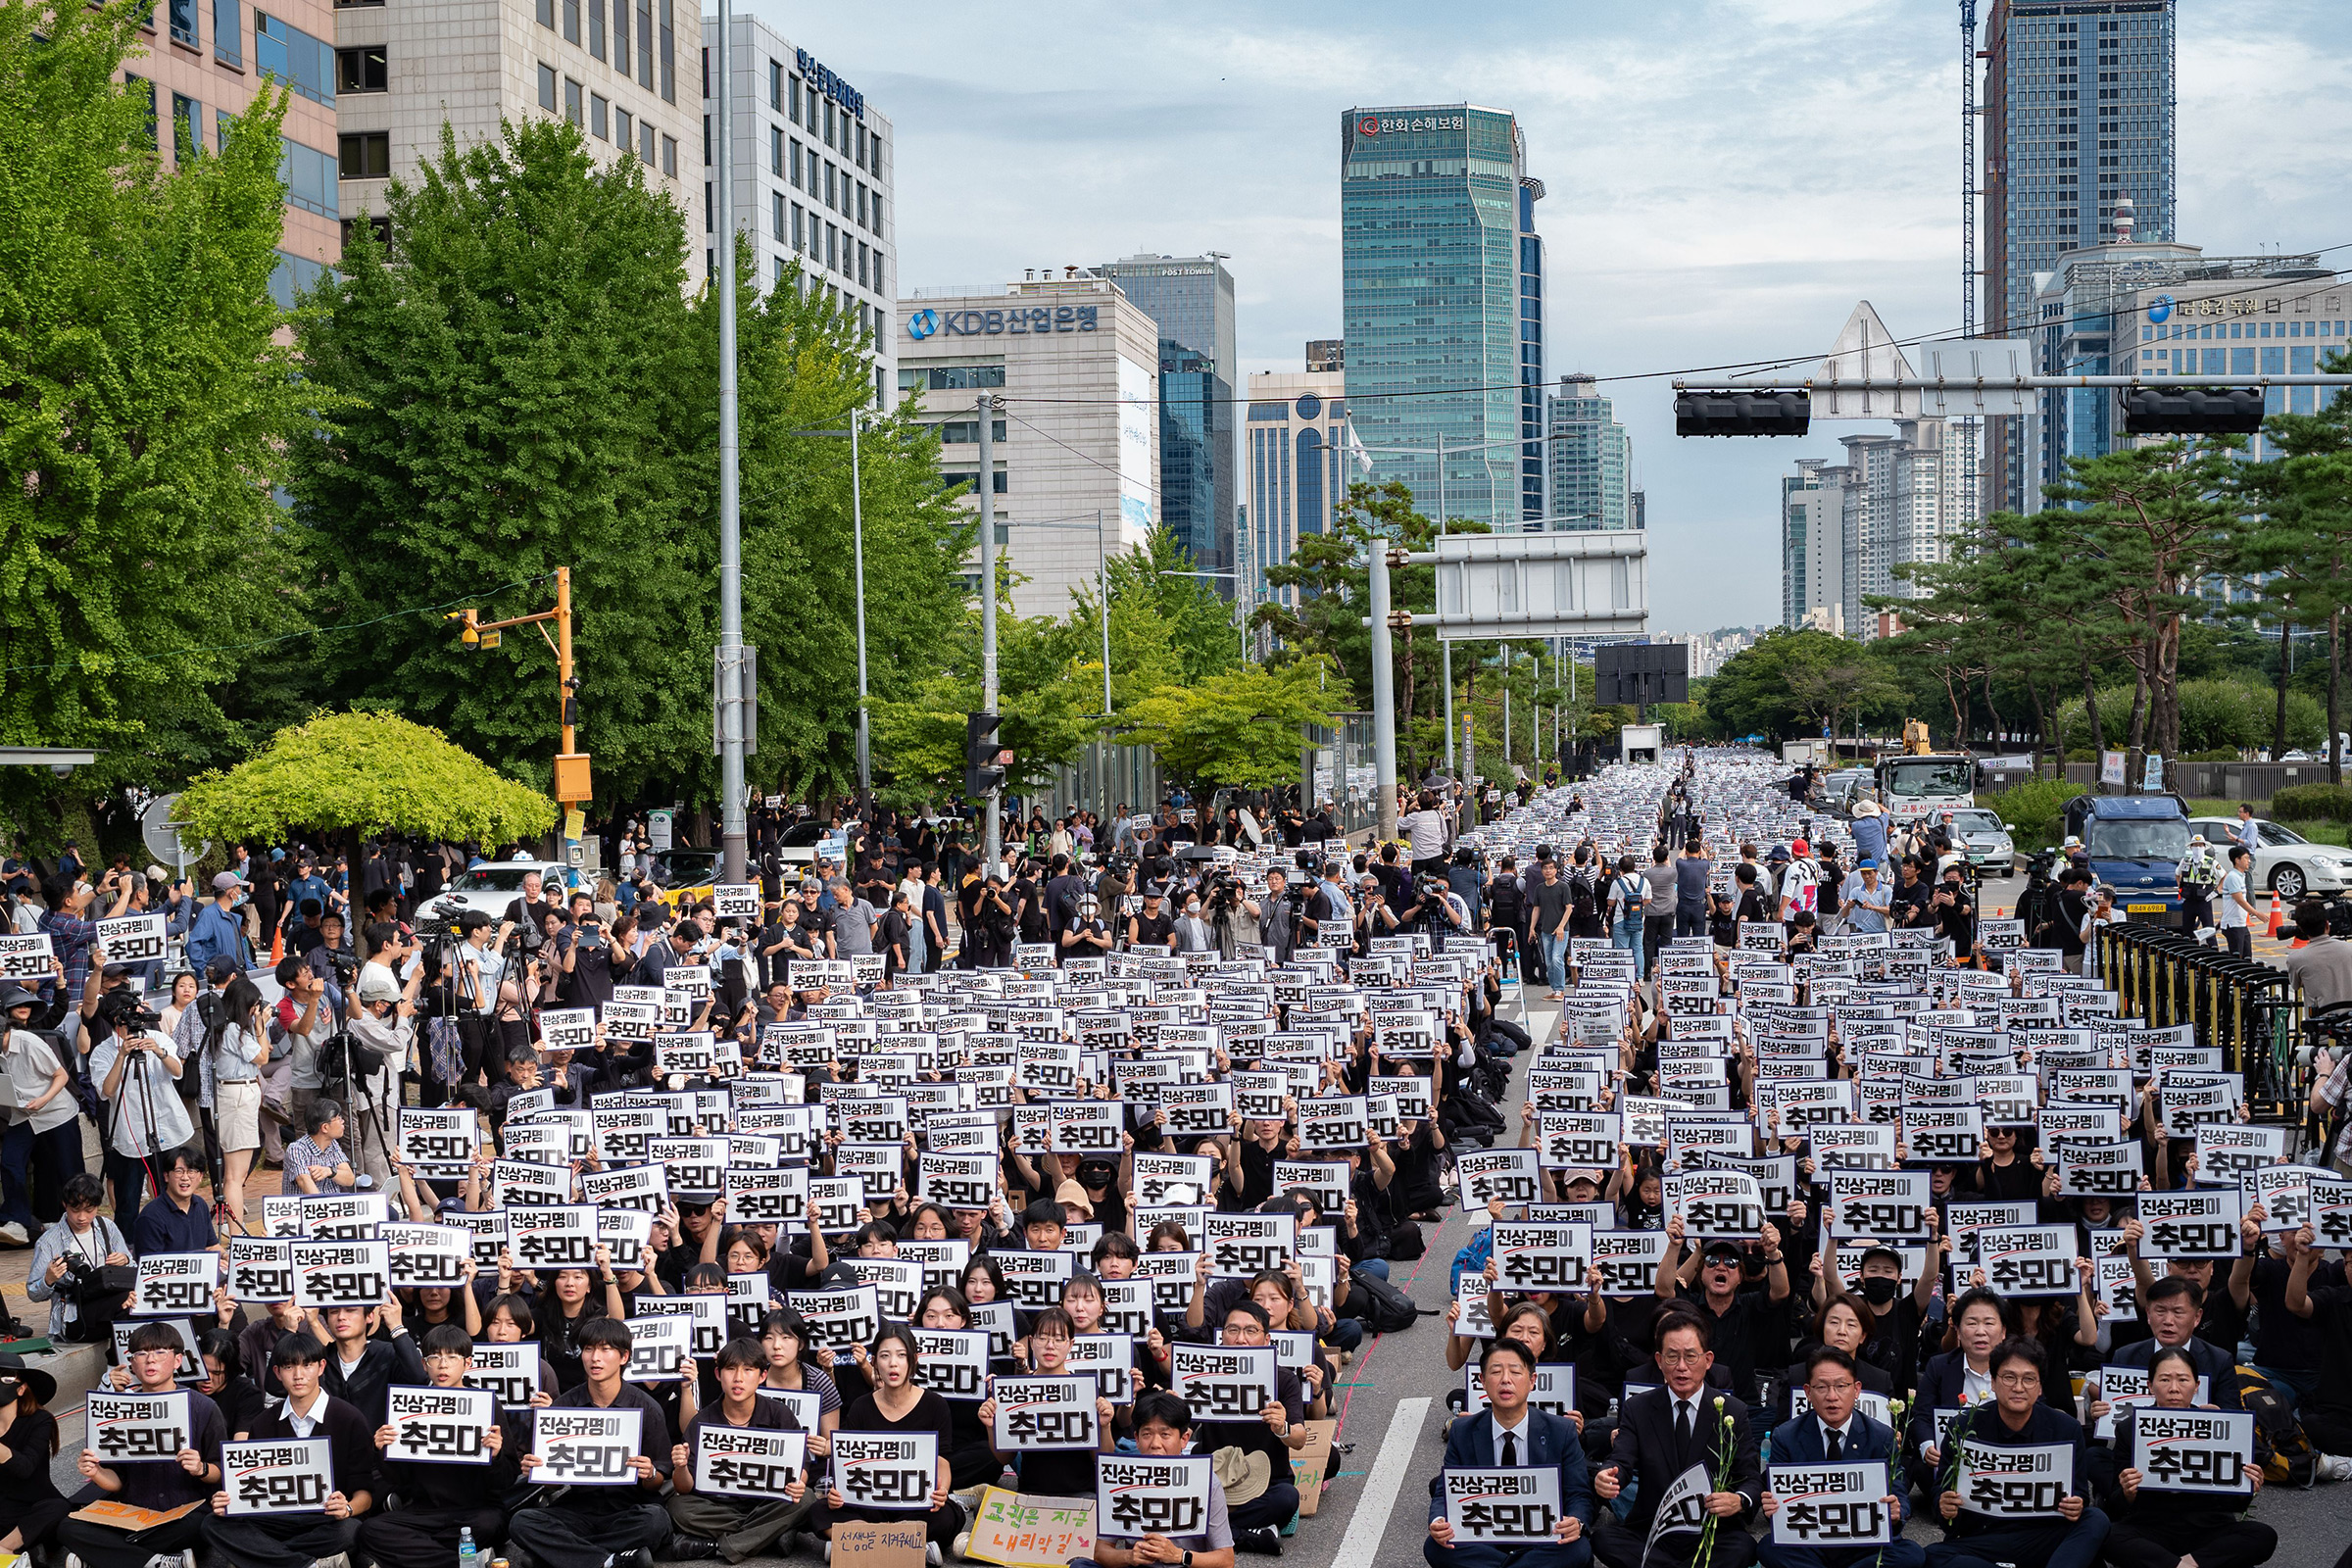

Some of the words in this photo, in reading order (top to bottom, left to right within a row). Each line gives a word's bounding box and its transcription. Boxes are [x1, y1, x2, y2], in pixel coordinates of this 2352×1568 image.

[1185, 267, 1213, 275] TOWER
[719, 899, 758, 913] 추모다
[98, 918, 153, 936] 진상규명이
[1319, 922, 1348, 931] 진상규명이
[107, 936, 165, 960] 추모다
[1320, 932, 1352, 946] 추모다
[1321, 933, 1352, 946] 추모다
[1743, 935, 1781, 950] 추모다
[1986, 933, 2024, 948] 추모다
[1020, 955, 1052, 967] 추모다
[794, 974, 827, 988] 추모다
[857, 967, 884, 981] 추모다
[1663, 980, 1708, 992] 진상규명이
[1667, 993, 1717, 1015] 추모다
[2001, 1003, 2048, 1013] 진상규명이
[608, 1018, 652, 1039] 추모다
[1377, 1015, 1423, 1027] 진상규명이
[549, 1027, 595, 1046] 추모다
[657, 1037, 702, 1049] 진상규명이
[780, 1033, 824, 1045] 진상규명이
[1081, 1032, 1132, 1051] 추모다
[1382, 1030, 1434, 1050] 추모다
[1943, 1035, 1996, 1050] 진상규명이
[2029, 1033, 2079, 1046] 진상규명이
[662, 1051, 713, 1070] 추모다
[786, 1047, 836, 1064] 추모다
[1019, 1046, 1067, 1060] 진상규명이
[2153, 1053, 2208, 1066] 진상규명이
[1022, 1060, 1076, 1087] 추모다
[1116, 1064, 1166, 1078] 진상규명이
[1371, 1081, 1419, 1093] 진상규명이
[1531, 1075, 1584, 1090] 진상규명이
[2060, 1075, 2118, 1089] 진상규명이
[1161, 1089, 1217, 1104] 진상규명이
[1234, 1091, 1286, 1115] 추모다
[1535, 1093, 1596, 1114] 추모다
[1778, 1086, 1838, 1102] 진상규명이
[840, 1102, 893, 1116] 진상규명이
[1053, 1106, 1108, 1121] 진상규명이
[1168, 1106, 1232, 1131] 추모다
[1298, 1102, 1351, 1118] 진상규명이
[401, 1114, 459, 1130] 진상규명이
[847, 1118, 906, 1141] 추모다
[1544, 1117, 1604, 1133] 진상규명이
[1905, 1112, 1968, 1128] 진상규명이
[2041, 1114, 2105, 1130] 진상규명이
[1058, 1123, 1121, 1149] 추모다
[1303, 1121, 1367, 1145] 추모다
[1673, 1129, 1738, 1145] 진상규명이
[1813, 1130, 1879, 1147] 진상규명이
[2200, 1129, 2267, 1148] 진상규명이
[406, 1132, 473, 1159] 추모다
[651, 1144, 713, 1160] 진상규명이
[1549, 1135, 1617, 1164] 추모다
[1912, 1131, 1982, 1156] 추모다
[921, 1158, 982, 1175] 진상규명이
[1137, 1158, 1196, 1175] 진상규명이
[1460, 1153, 1524, 1173] 진상규명이
[2062, 1150, 2129, 1165] 진상규명이
[2206, 1148, 2278, 1181] 추모다
[497, 1165, 556, 1186] 진상규명이
[586, 1172, 649, 1194] 진상규명이
[728, 1174, 793, 1190] 진상규명이
[2069, 1167, 2142, 1193] 추모다
[927, 1176, 994, 1205] 추모다
[1470, 1175, 1539, 1203] 추모다
[1684, 1176, 1752, 1196] 진상규명이
[1835, 1177, 1911, 1197] 진상규명이
[735, 1193, 806, 1218] 추모다
[2141, 1198, 2221, 1217] 진상규명이
[510, 1212, 579, 1230] 진상규명이
[1686, 1199, 1770, 1233] 추모다
[1842, 1200, 1928, 1234] 추모다
[381, 1229, 453, 1247] 진상규명이
[1207, 1220, 1277, 1239] 진상규명이
[1496, 1229, 1573, 1249] 진상규명이
[2150, 1220, 2238, 1252] 추모다
[517, 1233, 596, 1263] 추모다
[1982, 1232, 2058, 1253] 진상규명이
[295, 1248, 369, 1267] 진상규명이
[388, 1250, 467, 1281] 추모다
[1214, 1241, 1292, 1273] 추모다
[140, 1259, 202, 1276] 진상규명이
[1504, 1251, 1589, 1286] 추모다
[1990, 1256, 2077, 1291] 추모다
[143, 1279, 214, 1309] 추모다
[304, 1270, 388, 1301] 추모다
[791, 1296, 859, 1314] 진상규명이
[804, 1315, 875, 1348] 추모다
[1175, 1353, 1253, 1376] 진상규명이
[998, 1384, 1077, 1405] 진상규명이
[1182, 1378, 1272, 1416] 추모다
[88, 1400, 168, 1421] 진상규명이
[392, 1395, 472, 1416] 진상규명이
[539, 1416, 620, 1438] 진상규명이
[1006, 1408, 1096, 1445] 추모다
[2138, 1417, 2230, 1441] 진상규명이
[96, 1425, 188, 1456] 추모다
[400, 1418, 488, 1456] 추모다
[702, 1432, 785, 1456] 진상규명이
[226, 1446, 310, 1470] 진상규명이
[546, 1441, 634, 1477] 추모다
[835, 1440, 915, 1461] 진상규명이
[1962, 1451, 2052, 1474] 진상규명이
[2148, 1443, 2248, 1487] 추모다
[709, 1455, 798, 1494] 추모다
[844, 1464, 932, 1502] 추모다
[1101, 1463, 1188, 1489] 진상규명이
[1774, 1471, 1864, 1496] 진상규명이
[236, 1473, 330, 1508] 추모다
[1448, 1476, 1537, 1496] 진상규명이
[1970, 1475, 2069, 1513] 추모다
[984, 1501, 1040, 1529] 교권은
[1052, 1509, 1089, 1528] 지금
[1110, 1491, 1205, 1532] 추모다
[1459, 1499, 1558, 1537] 추모다
[1785, 1499, 1886, 1540] 추모다
